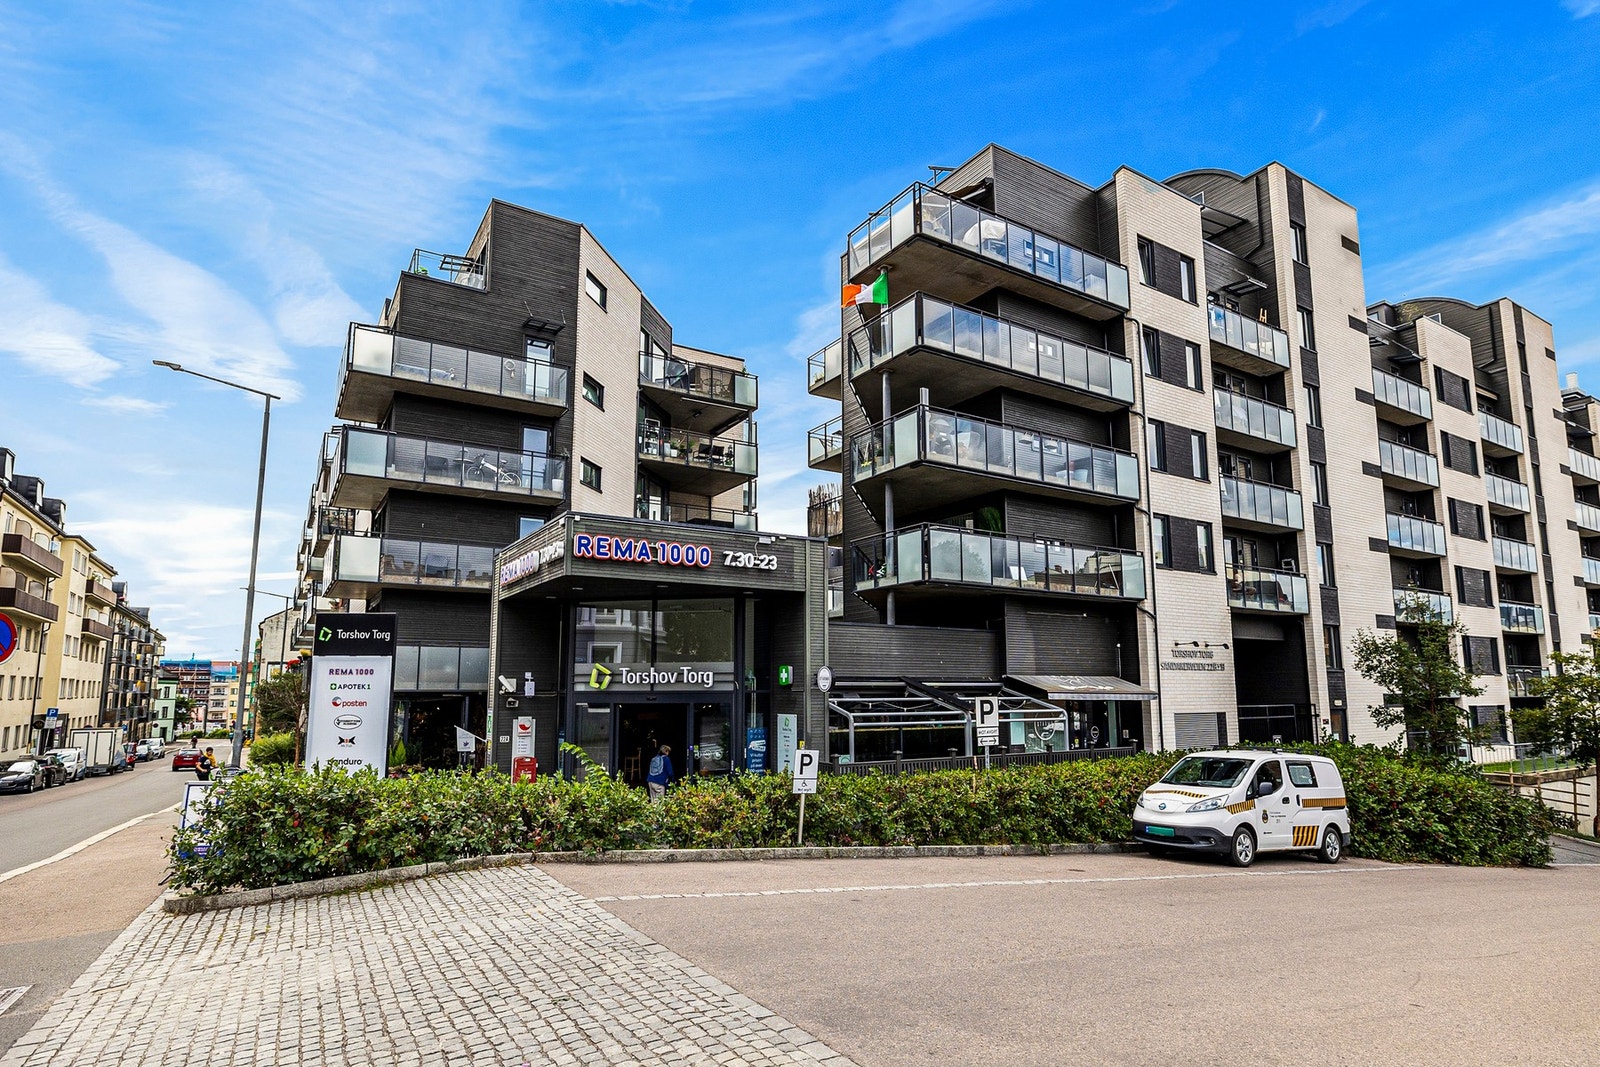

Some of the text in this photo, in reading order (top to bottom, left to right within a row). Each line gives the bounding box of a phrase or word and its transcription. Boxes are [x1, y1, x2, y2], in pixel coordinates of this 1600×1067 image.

[573, 533, 778, 570] REMA 1000 7.30-23
[337, 629, 391, 641] Torshov Torg
[618, 666, 714, 688] Torshov Torg
[980, 700, 994, 724] P
[799, 753, 813, 775] P
